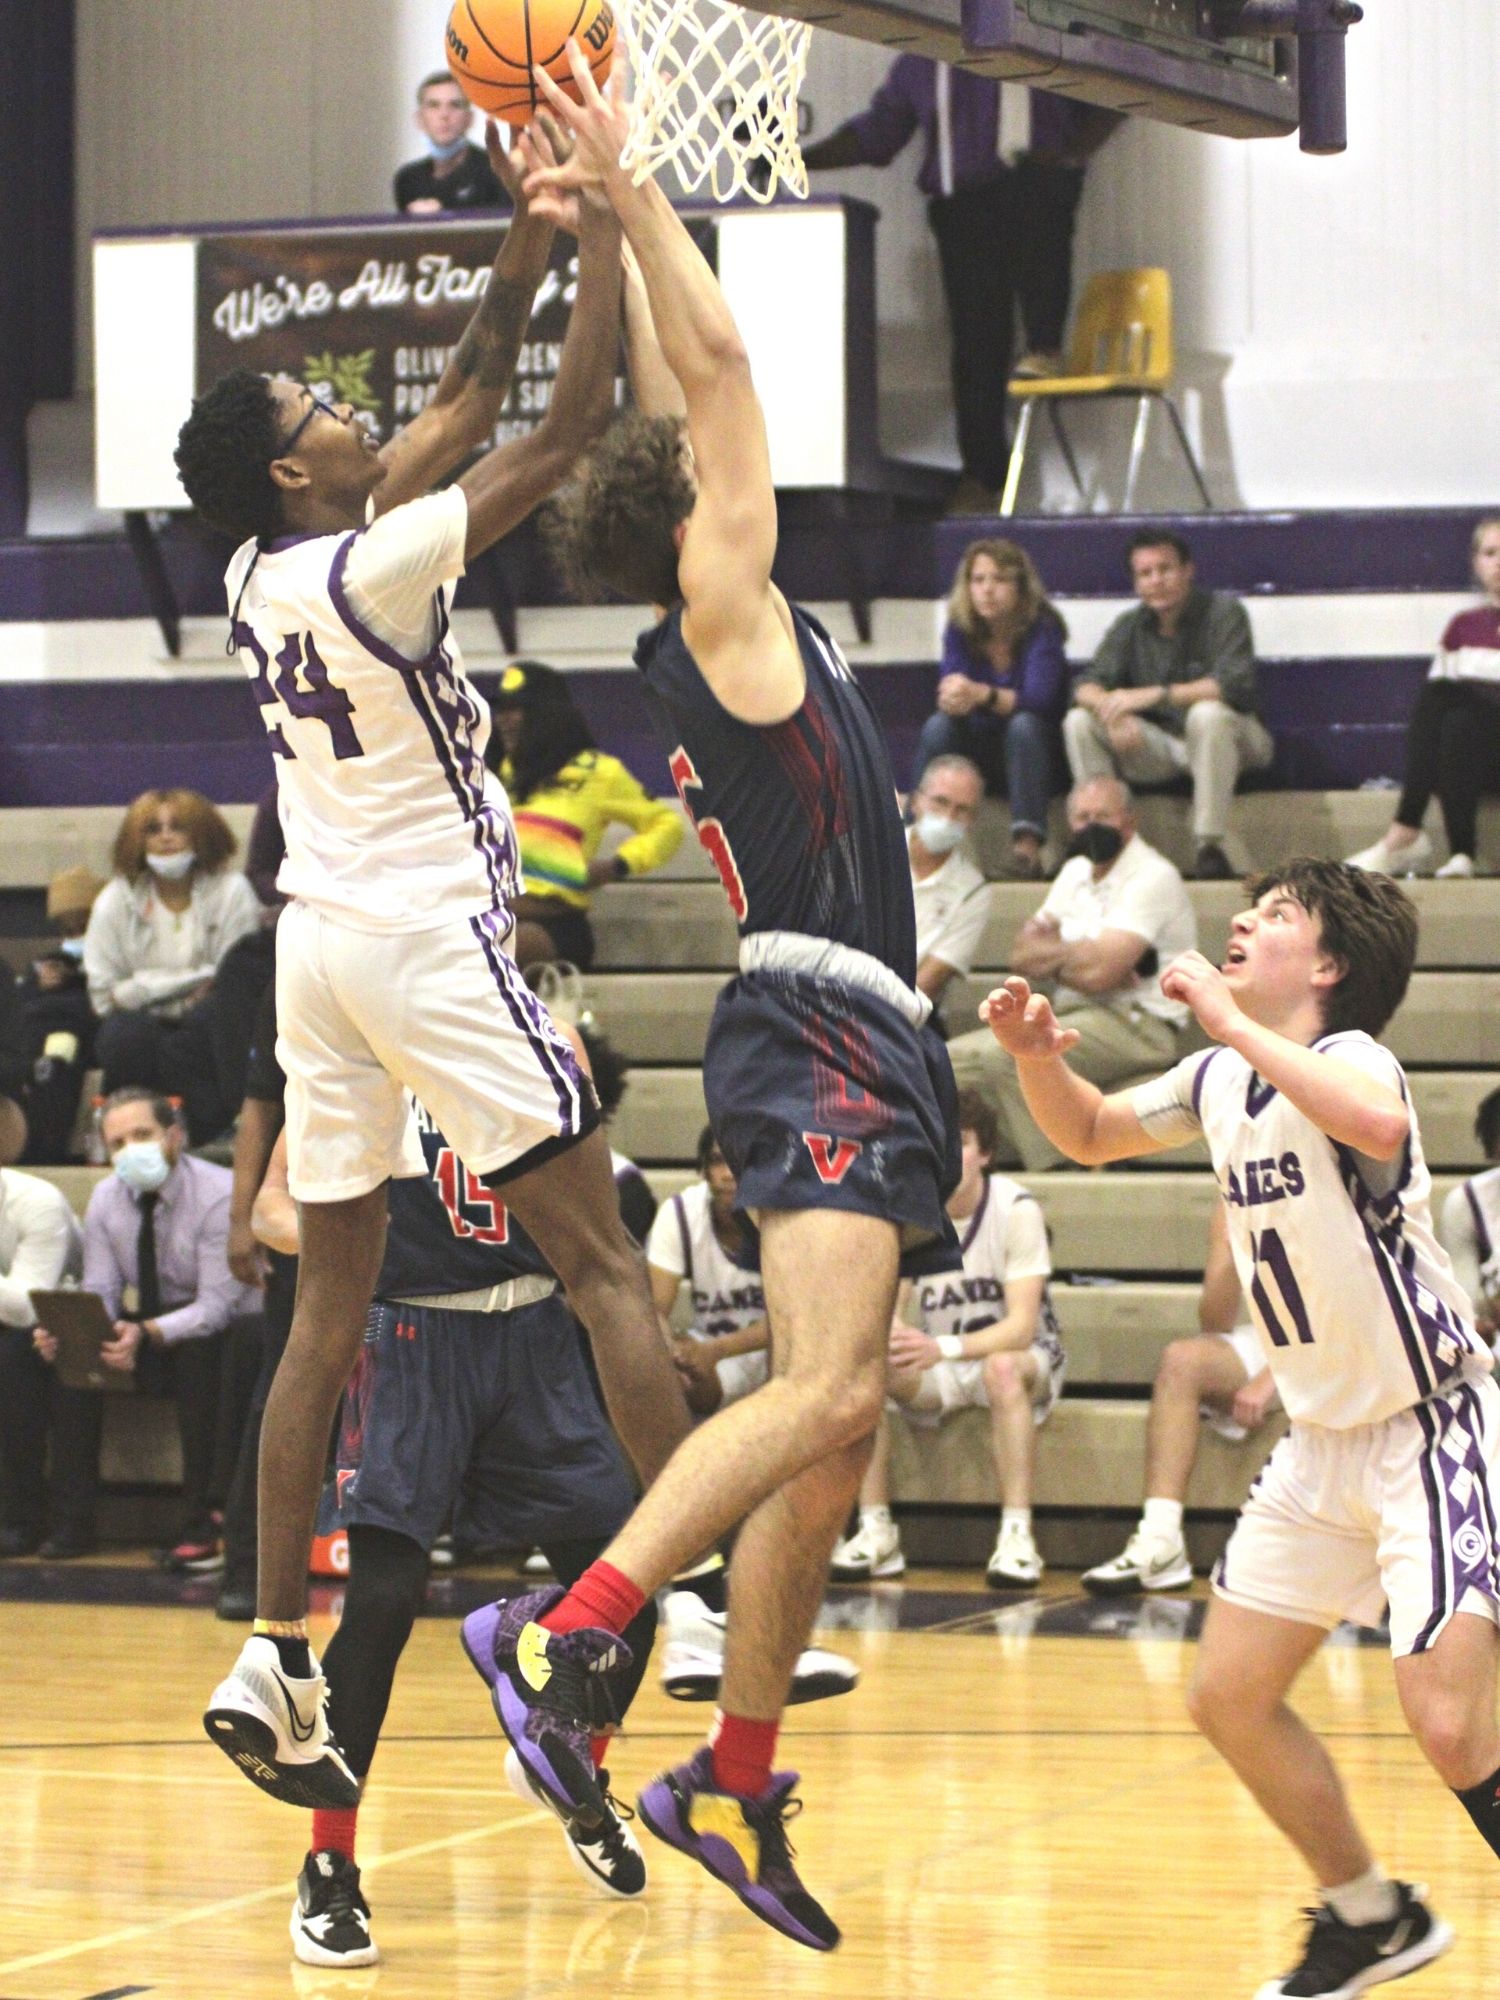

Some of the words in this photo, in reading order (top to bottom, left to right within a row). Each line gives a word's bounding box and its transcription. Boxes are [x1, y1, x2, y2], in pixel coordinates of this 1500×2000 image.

[213, 275, 334, 341] We're
[338, 260, 410, 310] All
[235, 621, 365, 760] 24
[802, 1131, 863, 1184] V
